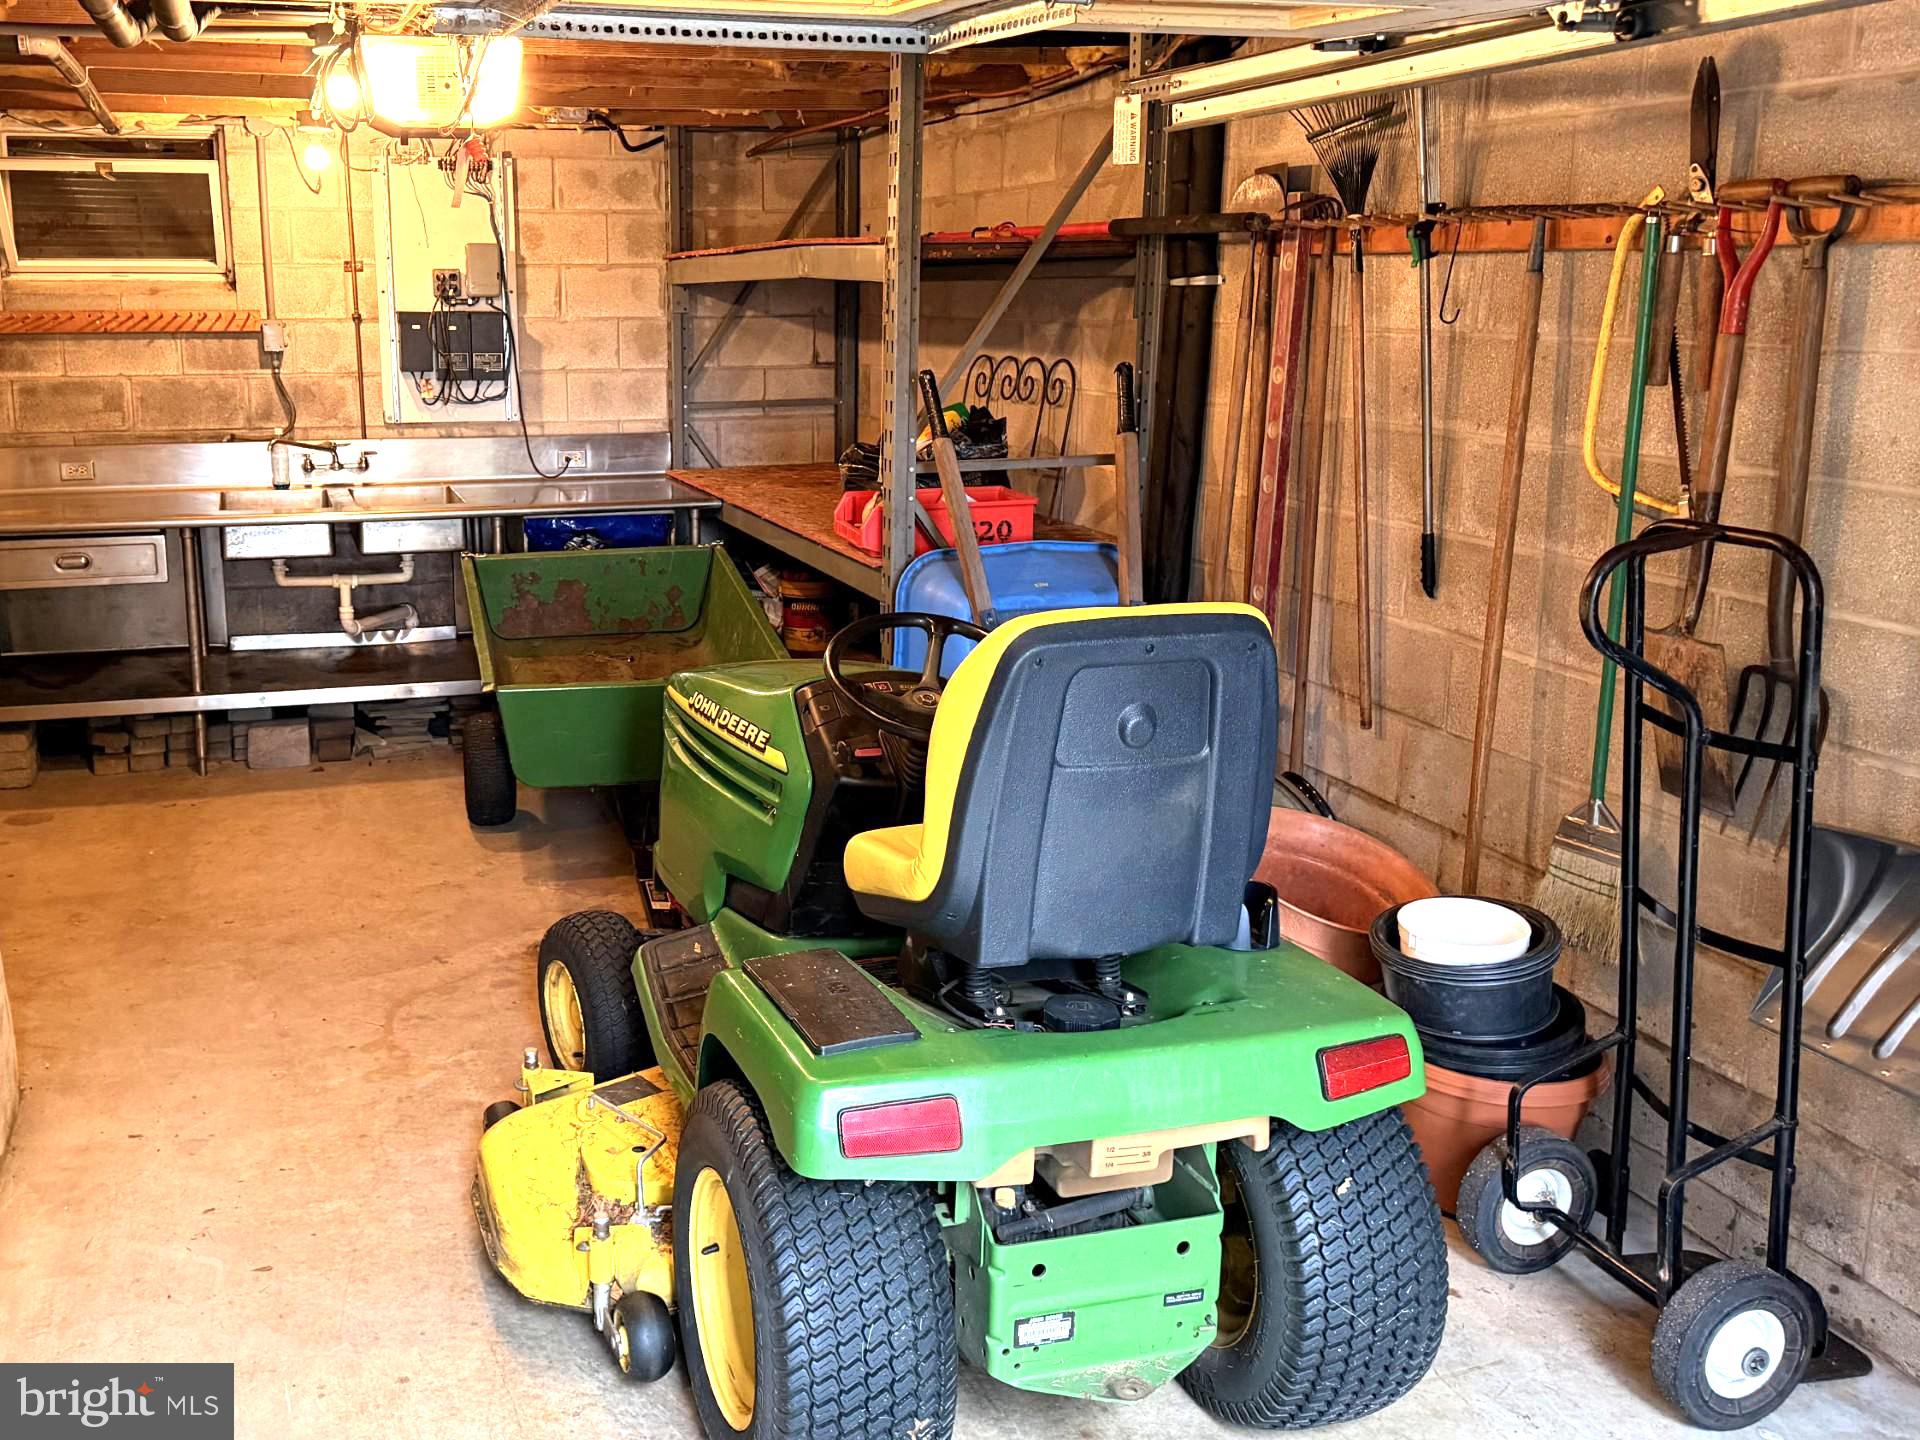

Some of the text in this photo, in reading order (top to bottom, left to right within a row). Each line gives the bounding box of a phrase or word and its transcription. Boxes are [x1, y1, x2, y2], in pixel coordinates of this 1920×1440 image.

[1129, 122, 1137, 162] WARNING
[973, 520, 1012, 541] 20
[688, 690, 771, 750] JOHN DEERE
